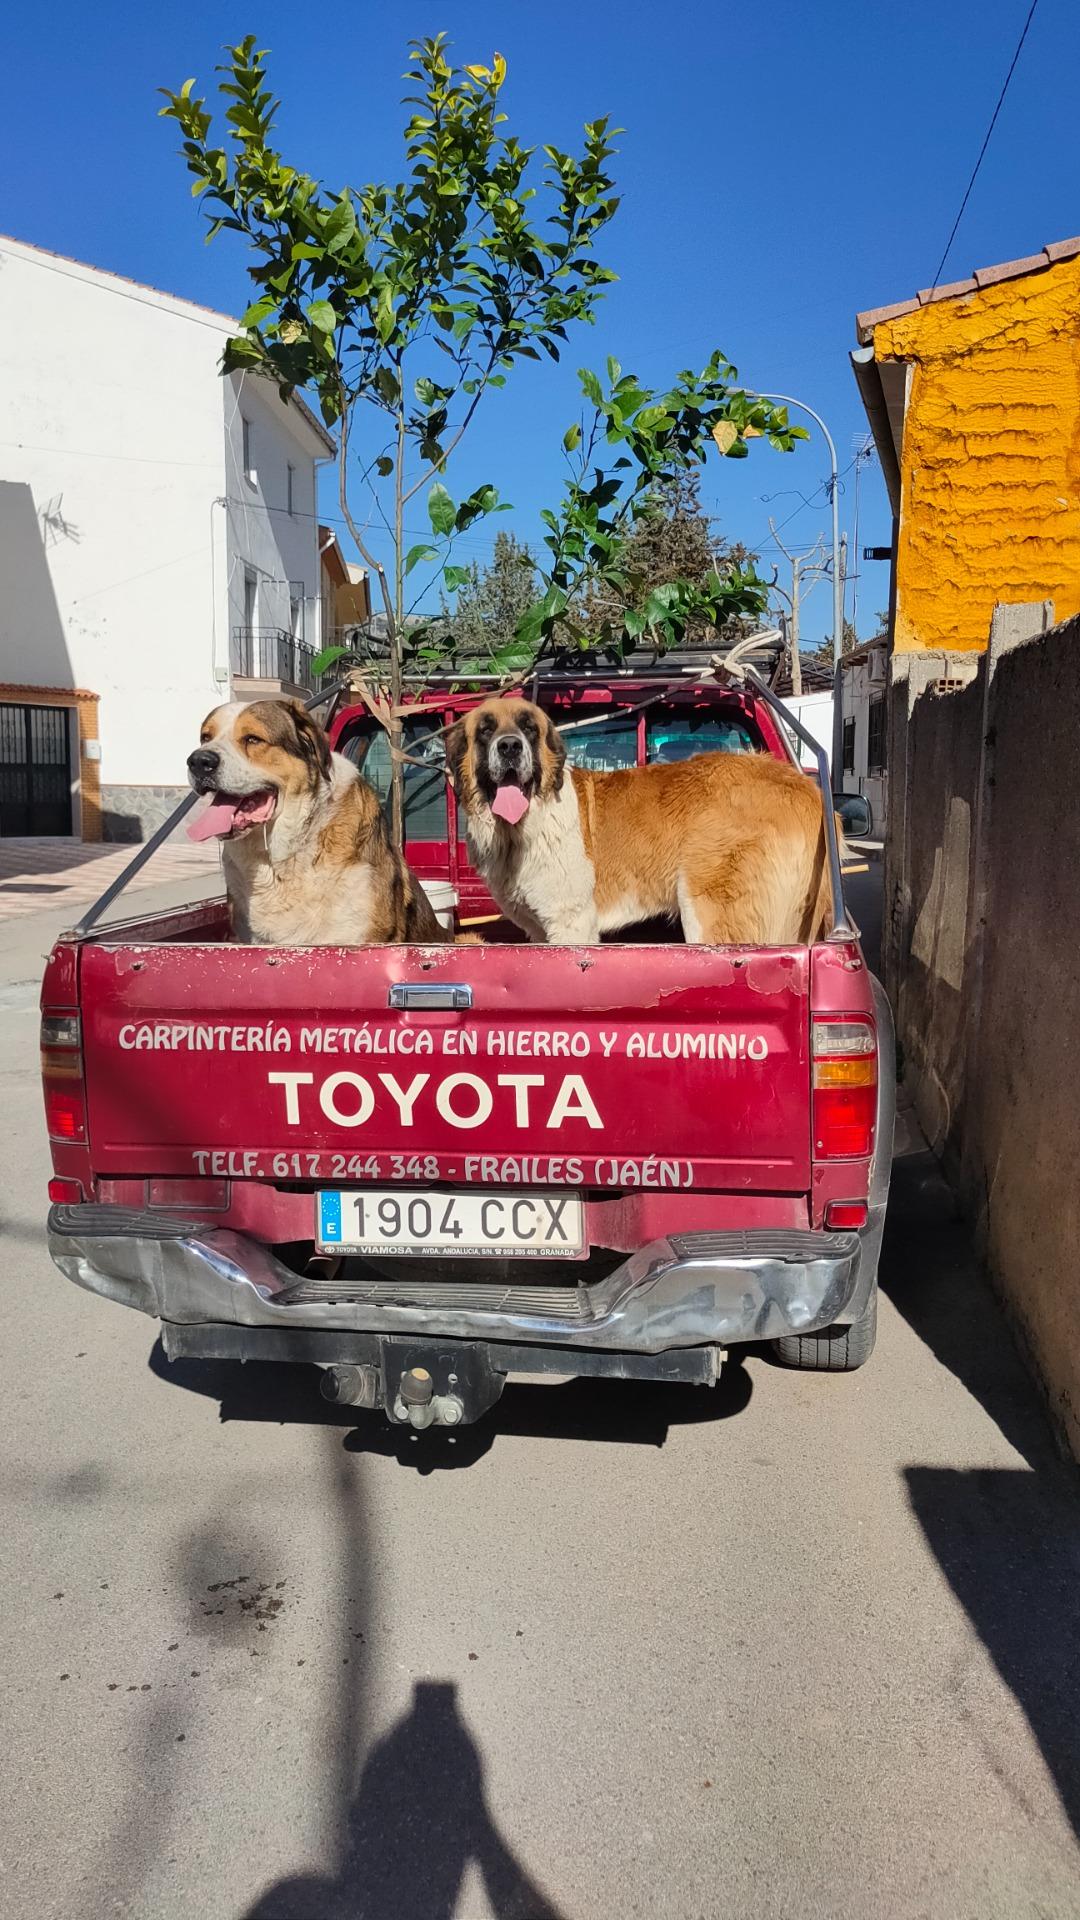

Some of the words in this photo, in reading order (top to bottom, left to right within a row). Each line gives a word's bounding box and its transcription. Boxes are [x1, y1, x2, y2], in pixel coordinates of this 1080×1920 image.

[119, 1020, 291, 1052] CARPINTERÍA
[300, 1021, 433, 1054] METÁLICA
[443, 1030, 477, 1055] EN
[487, 1030, 591, 1057] HIERRO
[600, 1032, 617, 1057] Y
[626, 1032, 768, 1060] ALUMINIO
[268, 1071, 604, 1129] TOYOTA
[192, 1151, 264, 1177] TELF.
[272, 1153, 320, 1178] 617
[331, 1154, 381, 1178] 244
[390, 1156, 439, 1179] 348
[465, 1156, 584, 1185] FRAILES
[595, 1153, 694, 1187] (JAÉN)
[327, 1222, 336, 1234] E
[353, 1197, 463, 1238] 1904
[481, 1199, 569, 1241] CCX
[360, 1246, 413, 1254] VIAMOSA
